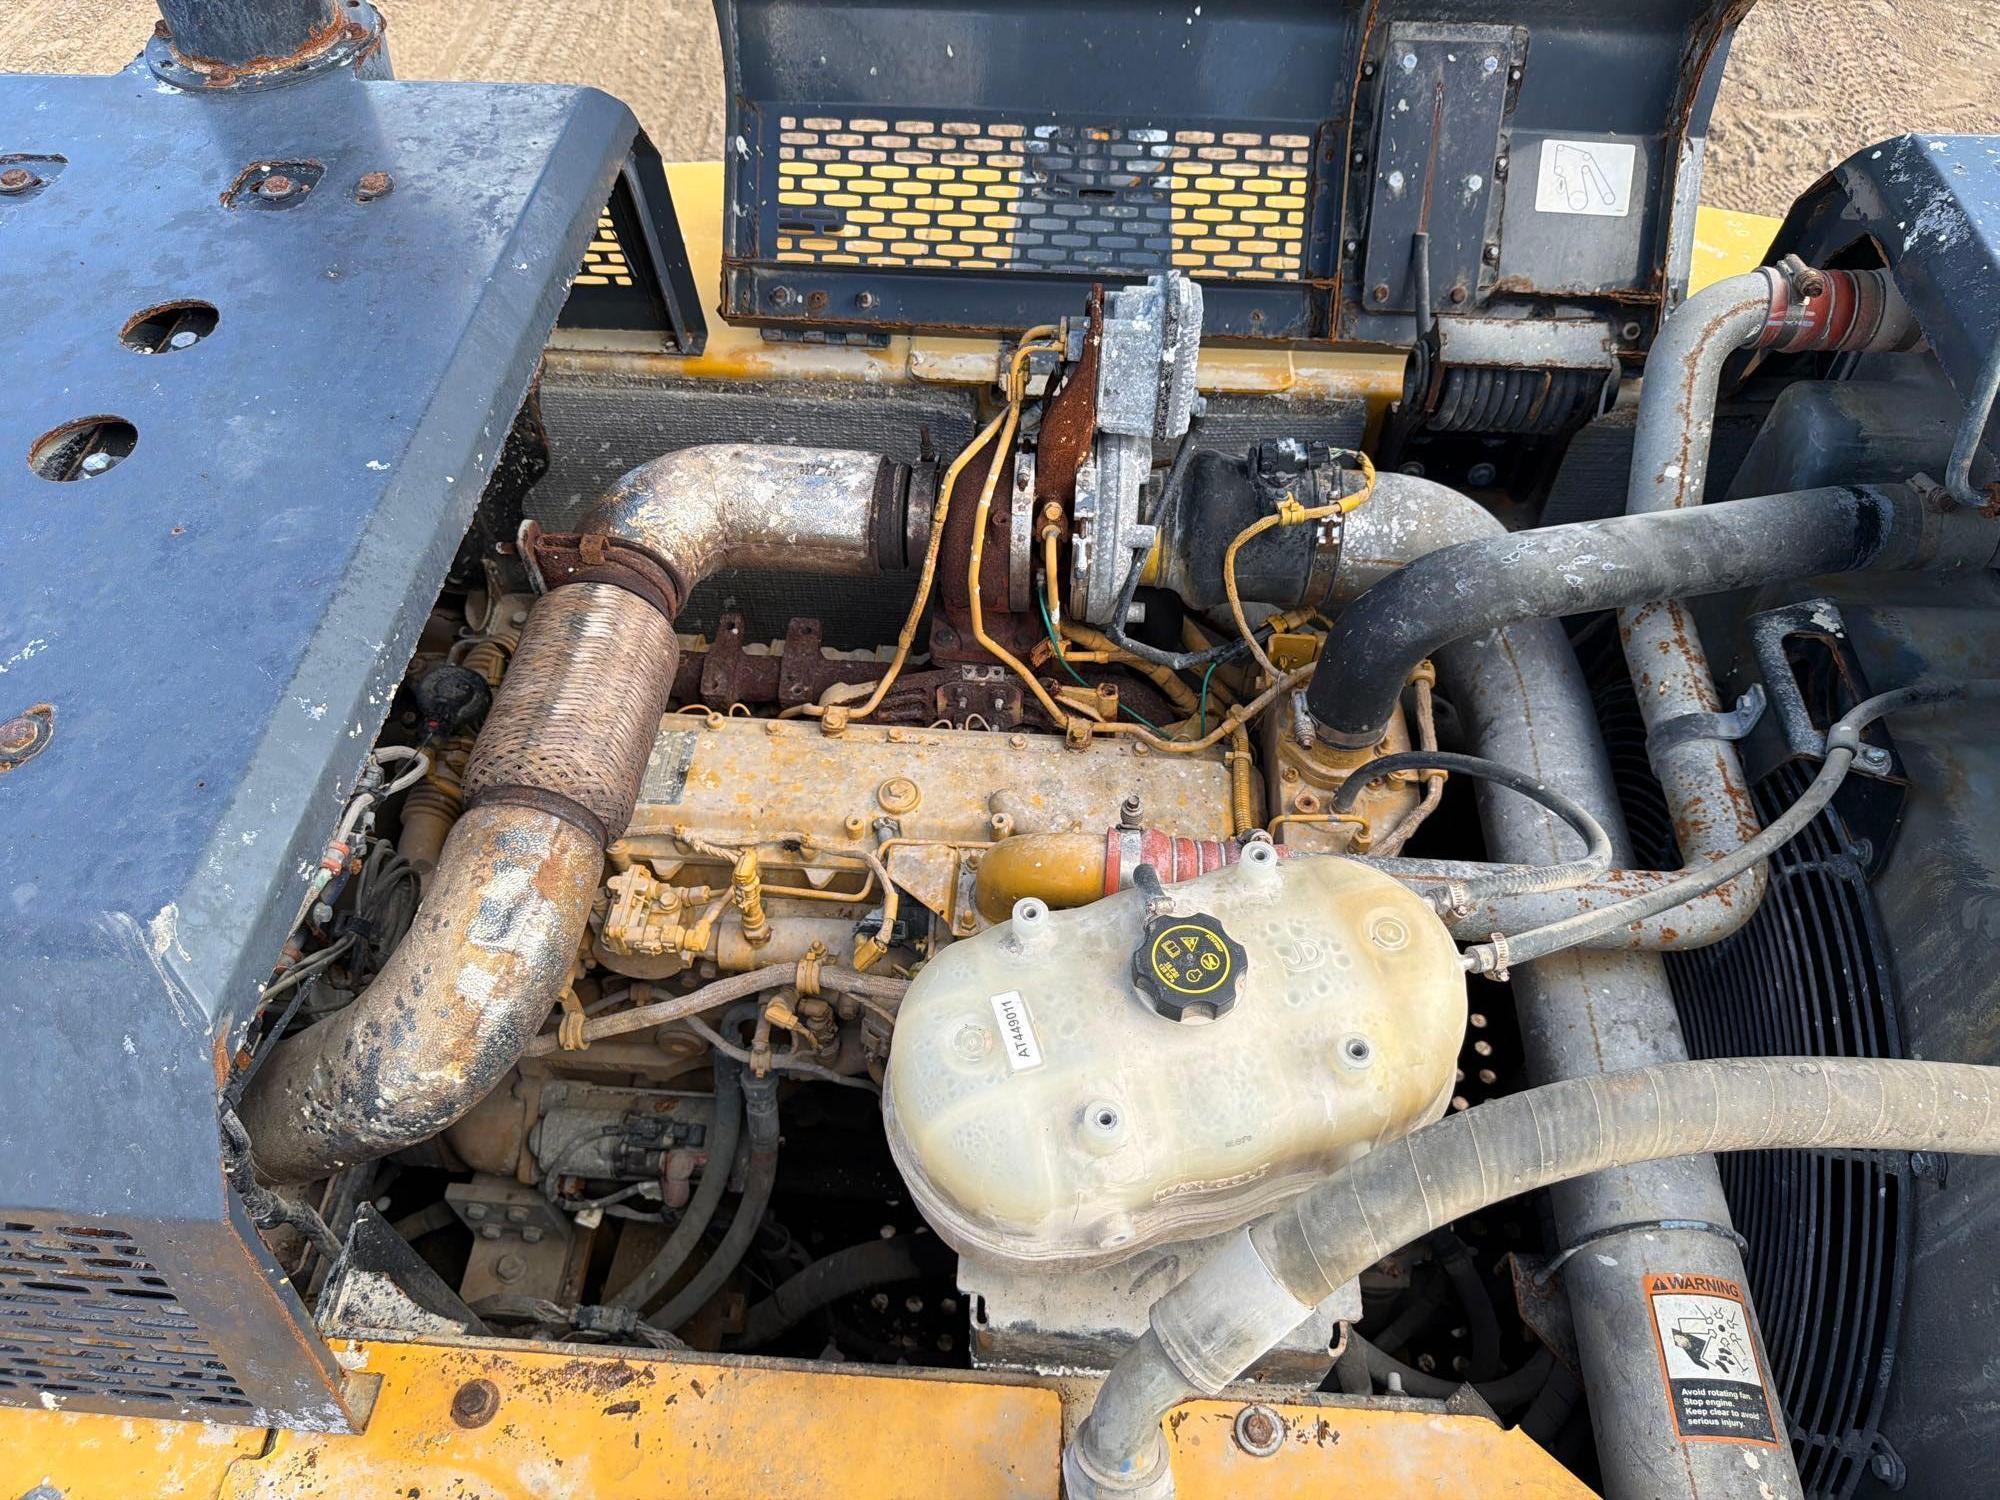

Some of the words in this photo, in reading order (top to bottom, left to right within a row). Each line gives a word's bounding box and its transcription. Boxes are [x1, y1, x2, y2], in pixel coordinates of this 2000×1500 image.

[1001, 1000, 1031, 1058] AT449011
[1667, 1276, 1739, 1298] WARNING
[1681, 1388, 1706, 1396] Avoid
[1708, 1389, 1738, 1400] rotating
[1739, 1391, 1753, 1400] fan.
[1683, 1398, 1704, 1406] Stop
[1705, 1399, 1735, 1408] engine.
[1685, 1407, 1708, 1416] Keep
[1709, 1408, 1729, 1416] clear
[1731, 1409, 1739, 1417] to
[1741, 1412, 1760, 1420] avoid
[1687, 1417, 1719, 1426] serious
[1721, 1418, 1745, 1428] injury.
